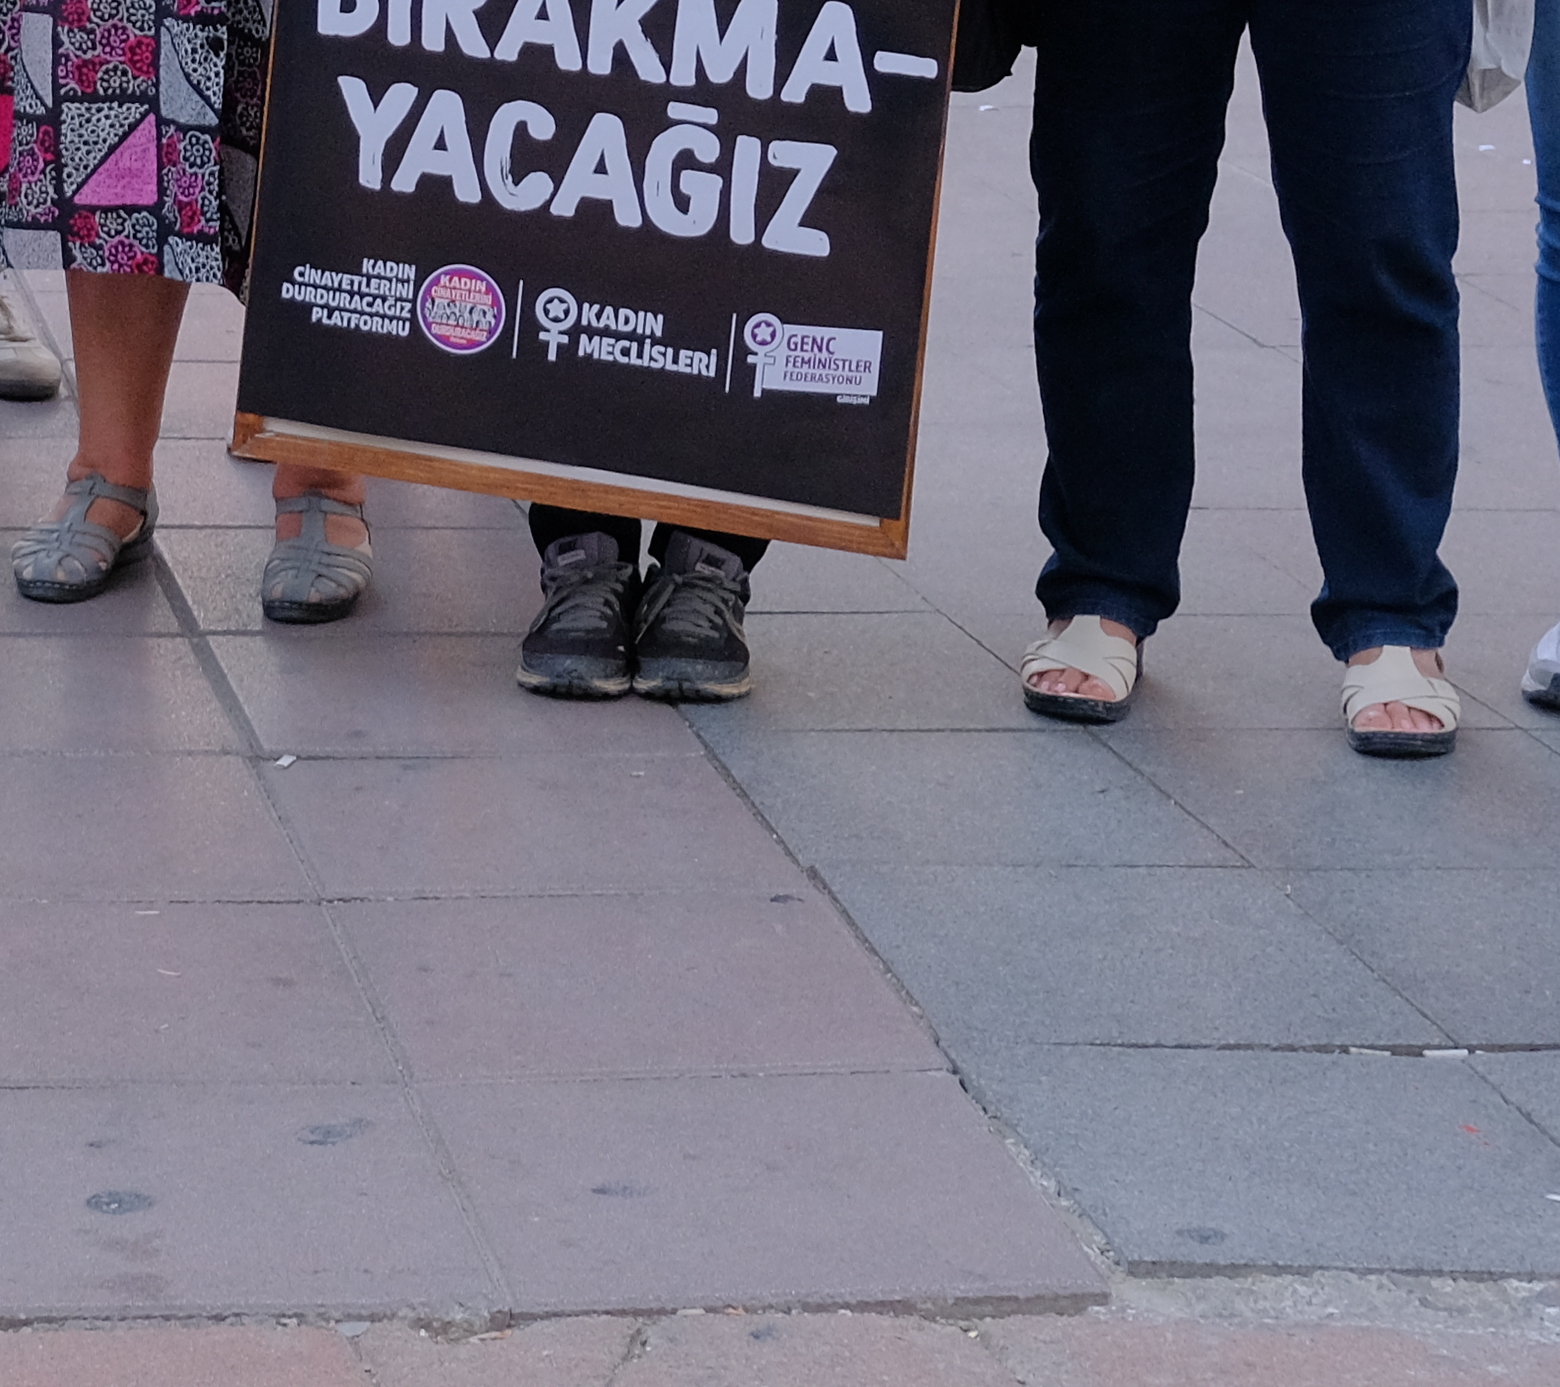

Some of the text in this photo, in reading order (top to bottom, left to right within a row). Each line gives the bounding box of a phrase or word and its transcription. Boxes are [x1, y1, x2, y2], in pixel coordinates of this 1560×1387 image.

[336, 74, 838, 258] YACAĞIZ
[293, 263, 415, 300] CİNAYETLERİNİ
[362, 257, 416, 280] KADIN
[440, 274, 487, 294] KADIN
[281, 281, 413, 319] DURDURACAĞIZ
[311, 306, 411, 337] PLATFORMU
[580, 302, 664, 338] KADIN
[578, 333, 718, 378] MECLİSLERİ
[786, 334, 837, 357] GENÇ
[782, 370, 863, 387] FEDERASYONU
[784, 352, 873, 375] FEMİNİSTLER
